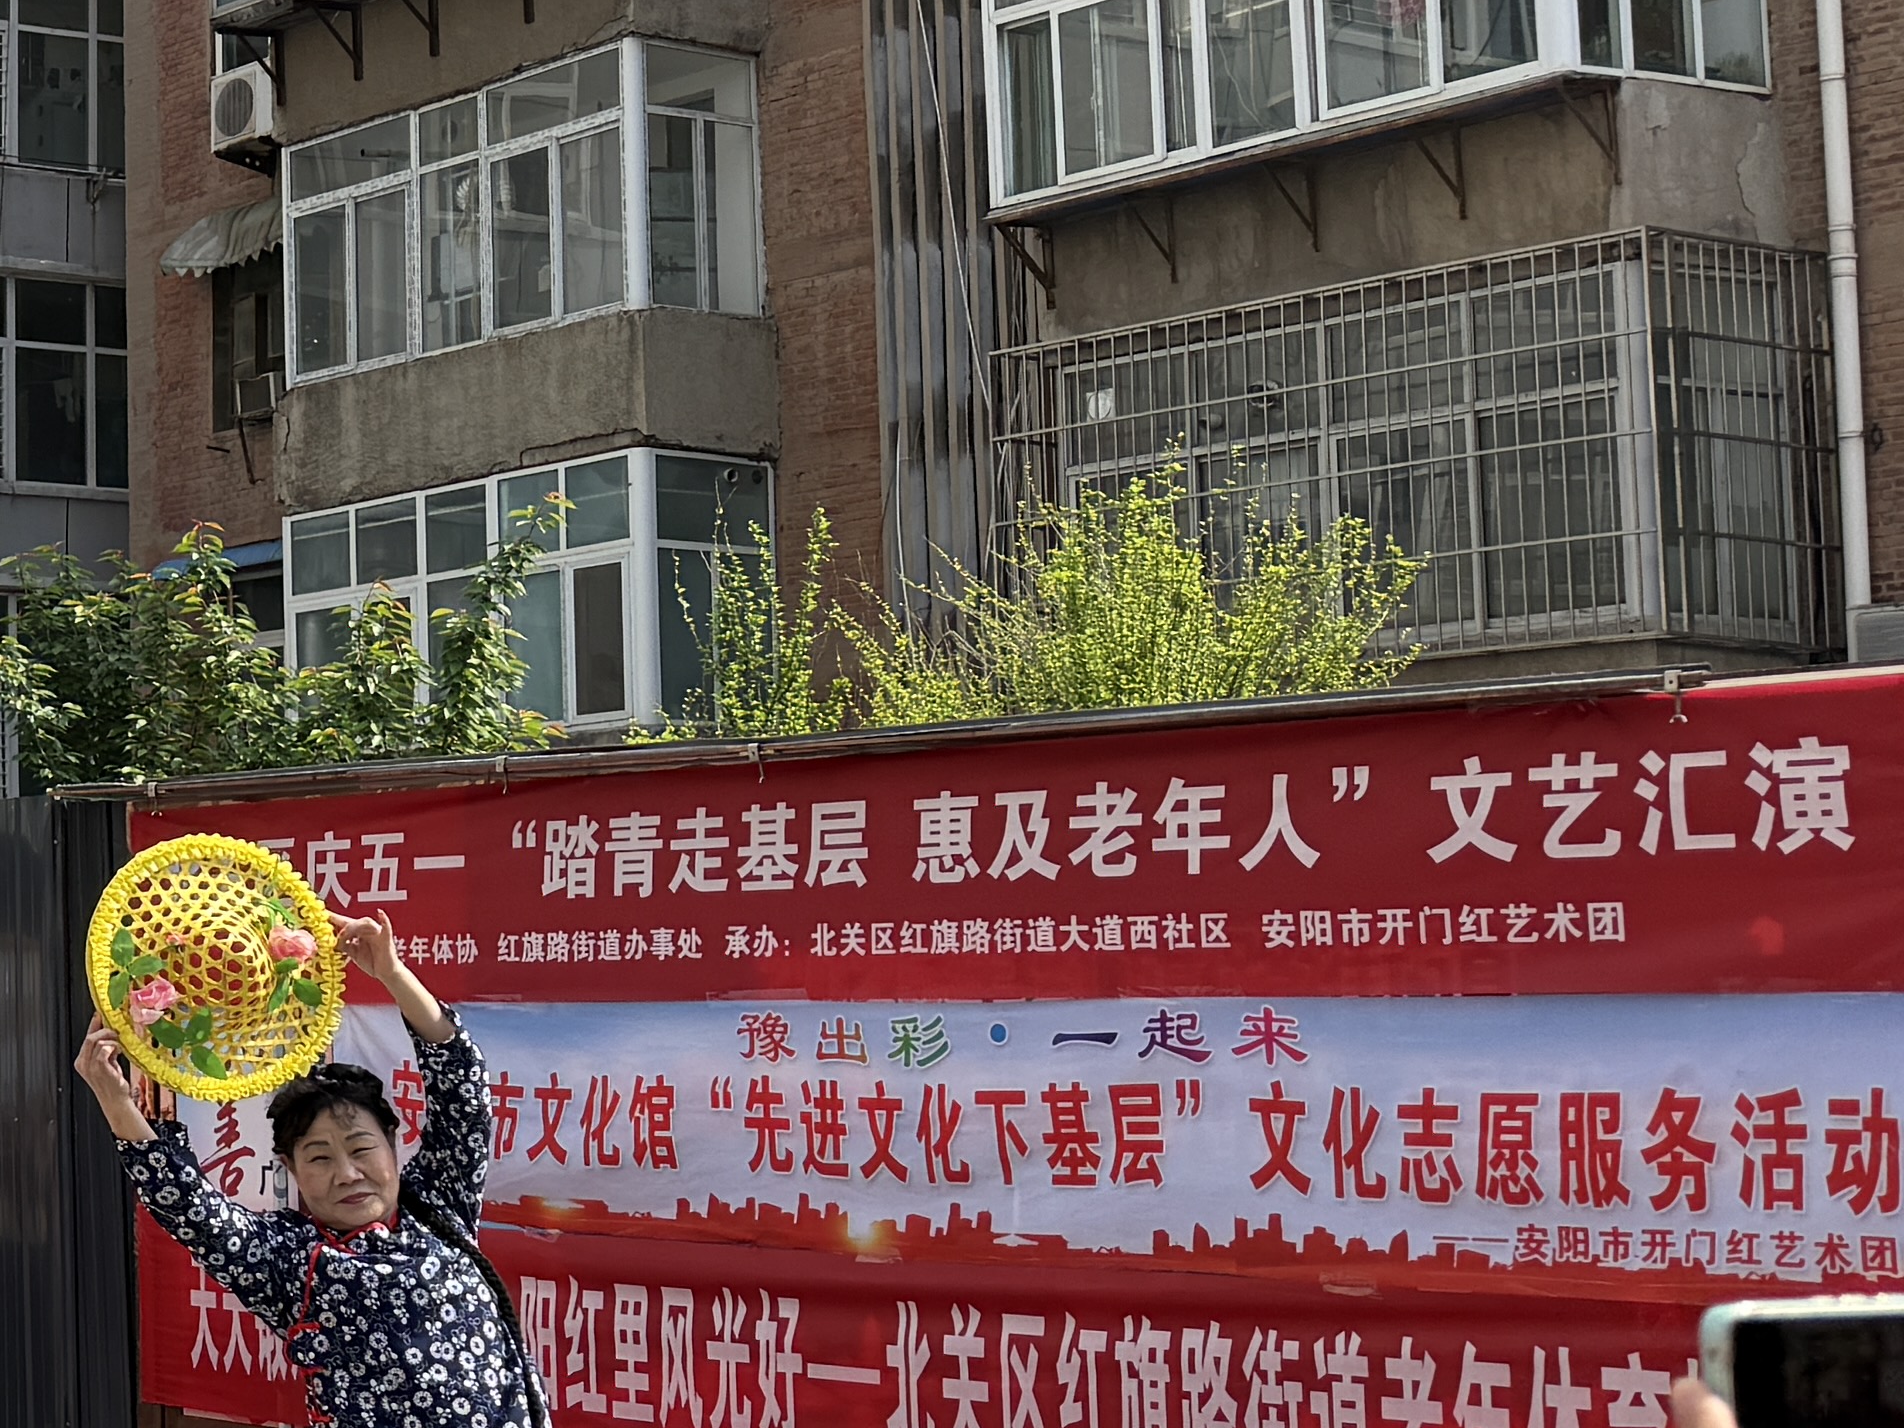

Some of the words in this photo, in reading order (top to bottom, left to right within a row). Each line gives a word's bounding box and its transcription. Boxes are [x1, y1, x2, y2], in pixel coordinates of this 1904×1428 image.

[257, 831, 465, 908] 庆五一
[1427, 736, 1856, 863] 文艺汇演
[497, 927, 703, 963] 红旗路街道办事处
[1261, 901, 1626, 948] 安阳市开门红艺术团
[1248, 1078, 1900, 1217] 文化志愿服务活动
